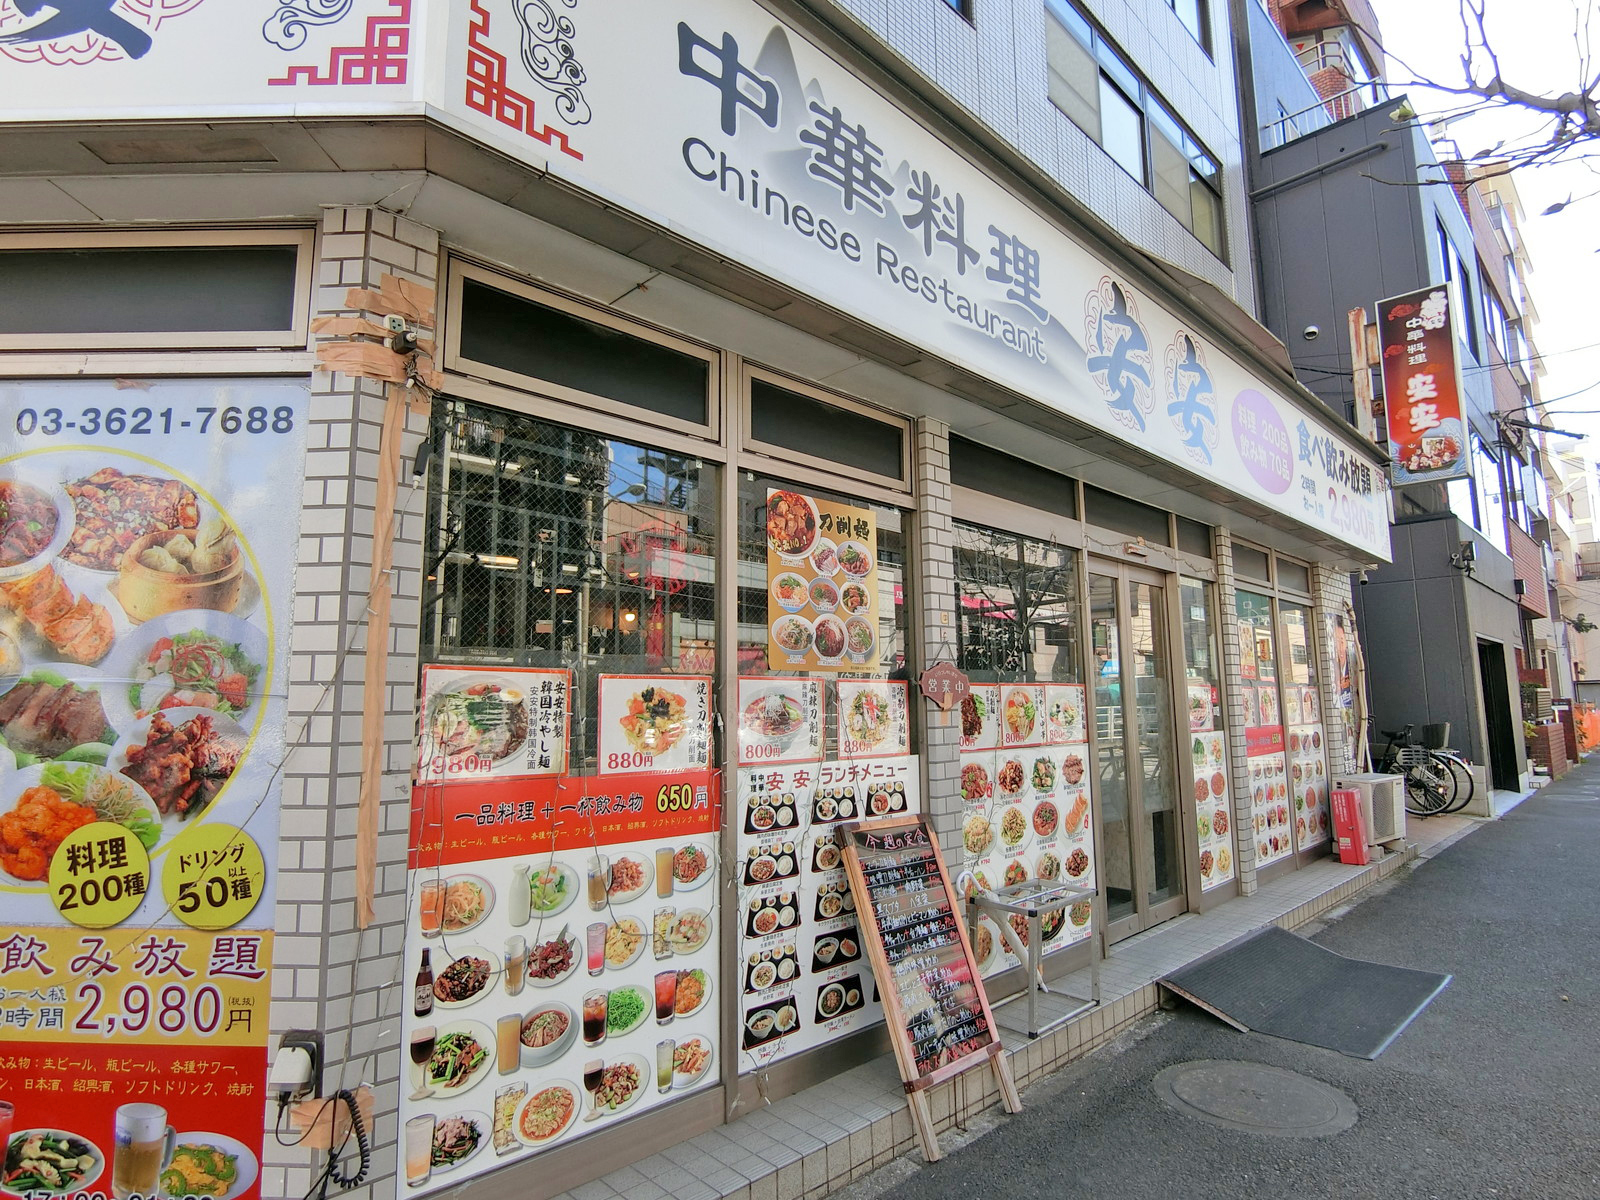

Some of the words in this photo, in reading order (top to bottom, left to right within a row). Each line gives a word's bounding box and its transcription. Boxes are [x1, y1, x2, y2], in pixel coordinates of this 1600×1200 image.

[677, 21, 1051, 323] 中華料理
[682, 137, 861, 263] Chinese
[876, 242, 1049, 364] Restaurant
[16, 406, 295, 436] 03-3621-7688
[1296, 418, 1373, 498] 食べ飲み放題
[928, 678, 964, 693] 営業中
[553, 680, 567, 738] 安安特製
[432, 755, 492, 774] 980円
[608, 752, 653, 769] 880円
[745, 743, 781, 759] 800円
[821, 763, 908, 785] ランチメニュー
[67, 836, 128, 876] 料理
[866, 828, 929, 853] 今週の定食
[178, 843, 247, 874] ドリング
[58, 872, 146, 911] 200種
[178, 877, 253, 914] 50種
[0, 933, 266, 980] 飲み放題
